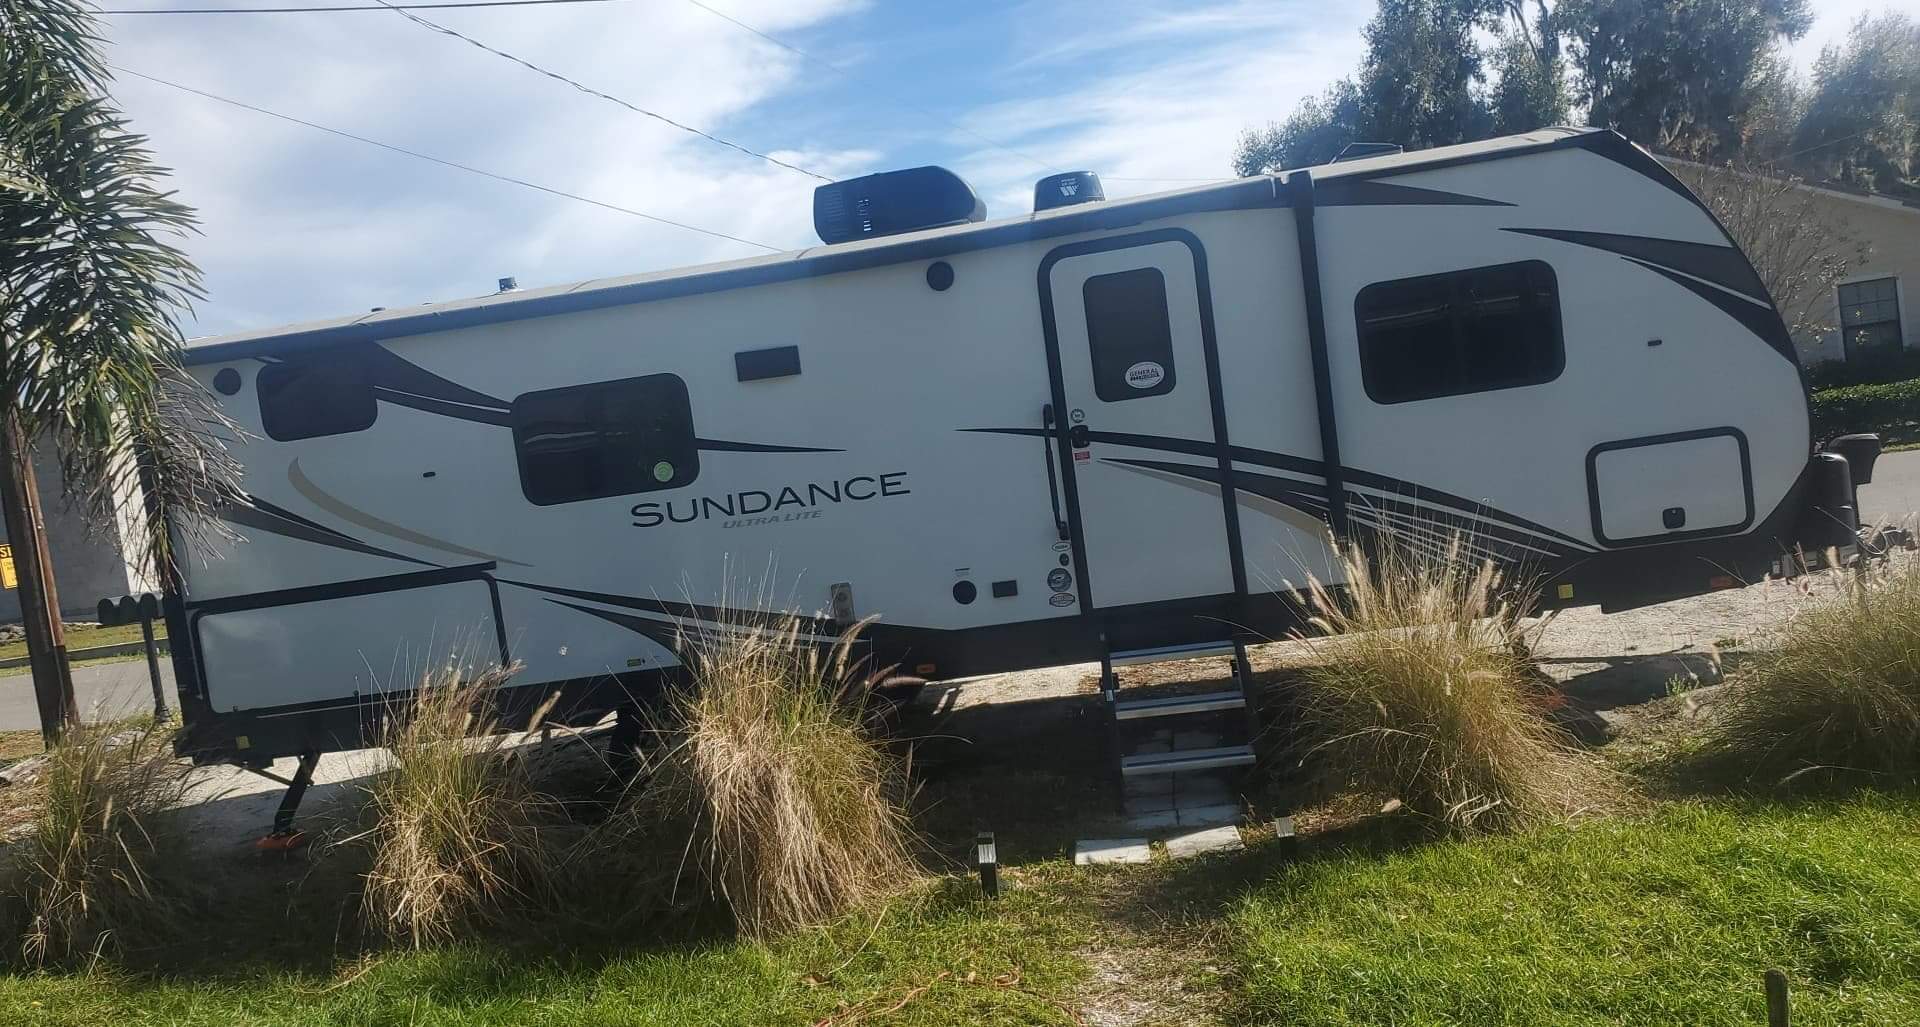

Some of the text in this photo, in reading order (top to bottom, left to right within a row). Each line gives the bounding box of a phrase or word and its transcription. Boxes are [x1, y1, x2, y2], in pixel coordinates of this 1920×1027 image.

[630, 471, 911, 528] SUNDANCE
[722, 509, 824, 529] ULTRA LITE
